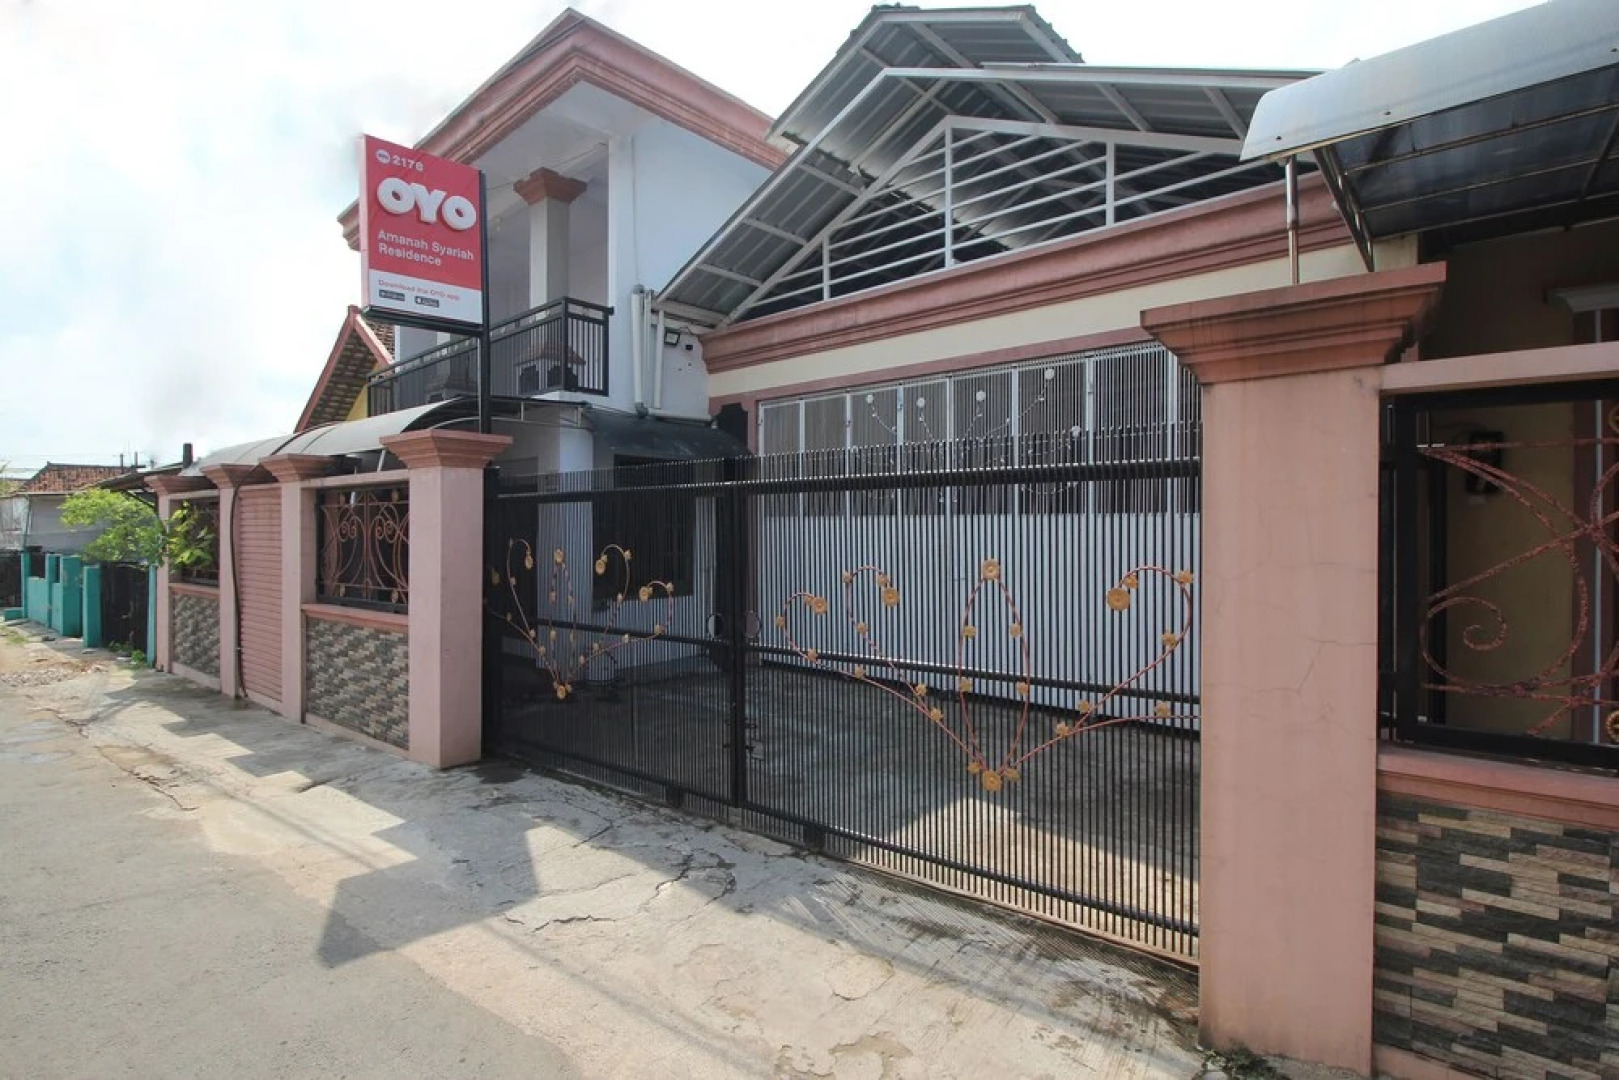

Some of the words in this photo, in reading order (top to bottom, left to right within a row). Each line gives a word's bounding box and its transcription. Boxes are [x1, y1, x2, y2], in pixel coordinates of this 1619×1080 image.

[377, 177, 477, 230] OYO
[378, 230, 429, 250] Amanah
[431, 240, 475, 261] Syariah
[378, 243, 441, 267] Residence
